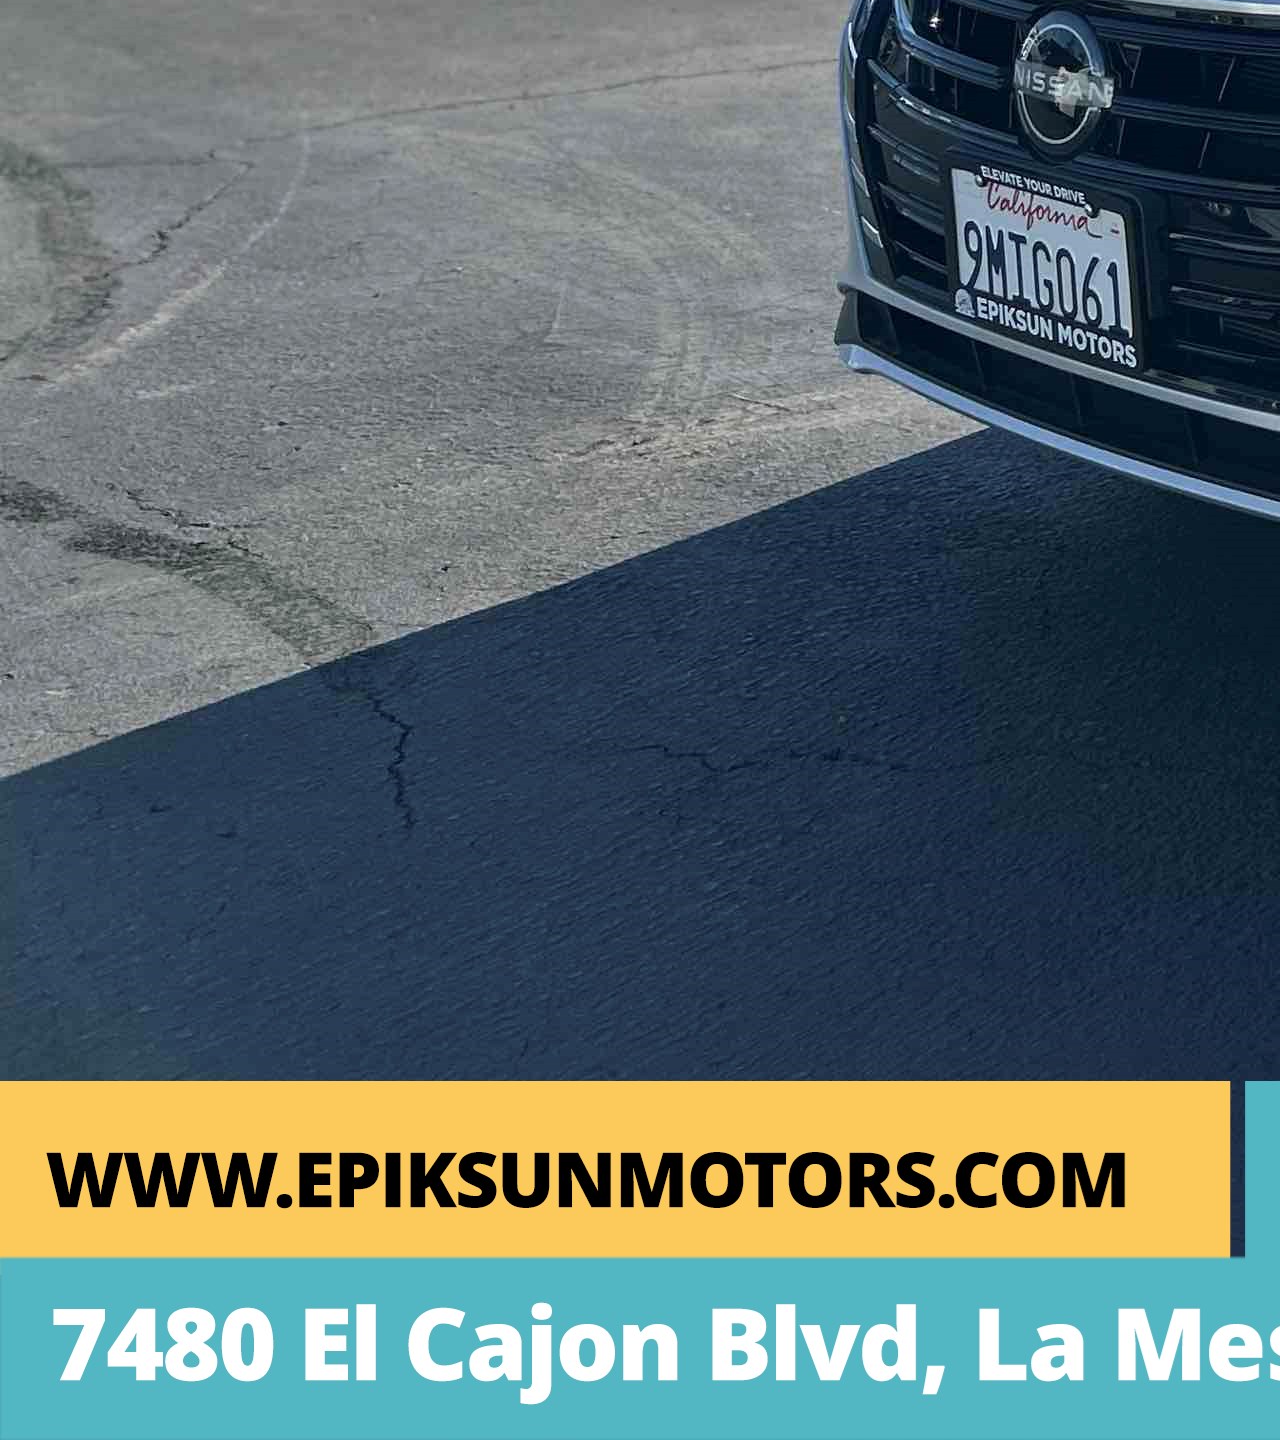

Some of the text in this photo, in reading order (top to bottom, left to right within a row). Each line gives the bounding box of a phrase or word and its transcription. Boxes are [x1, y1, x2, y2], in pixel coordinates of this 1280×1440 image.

[1013, 62, 1108, 104] NISSAN
[980, 165, 1087, 205] ELEVATE YOUR DRIVE
[985, 180, 1102, 238] California
[976, 296, 1138, 369] EPIKSUN MOTORS
